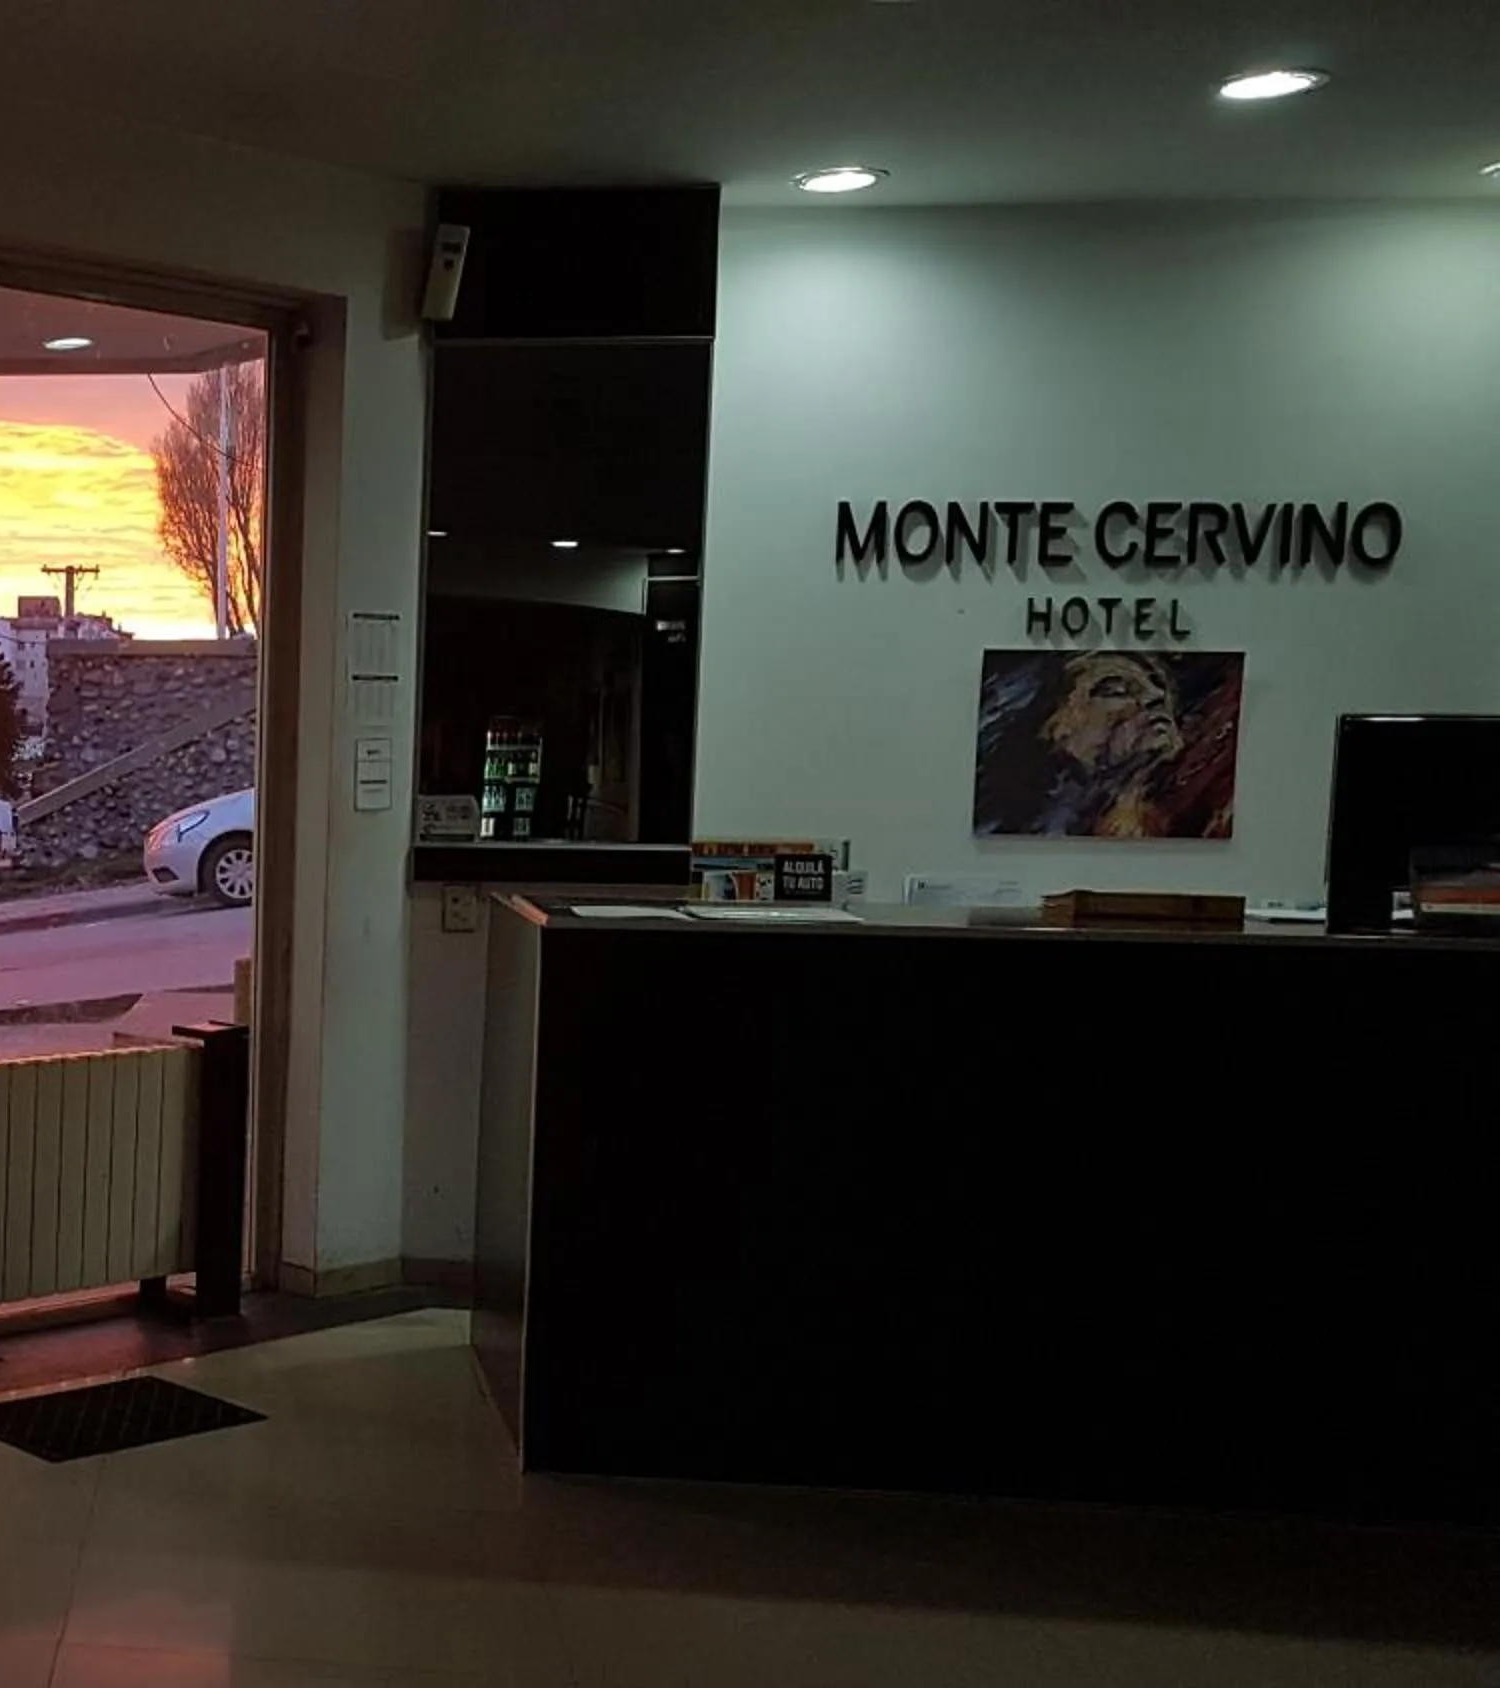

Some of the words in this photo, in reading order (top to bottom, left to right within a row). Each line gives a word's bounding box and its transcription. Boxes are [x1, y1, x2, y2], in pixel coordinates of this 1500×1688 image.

[835, 499, 1074, 566] MONTE
[1095, 500, 1402, 568] CERVINO
[1026, 596, 1191, 640] HOTEL
[798, 876, 824, 890] AUTO
